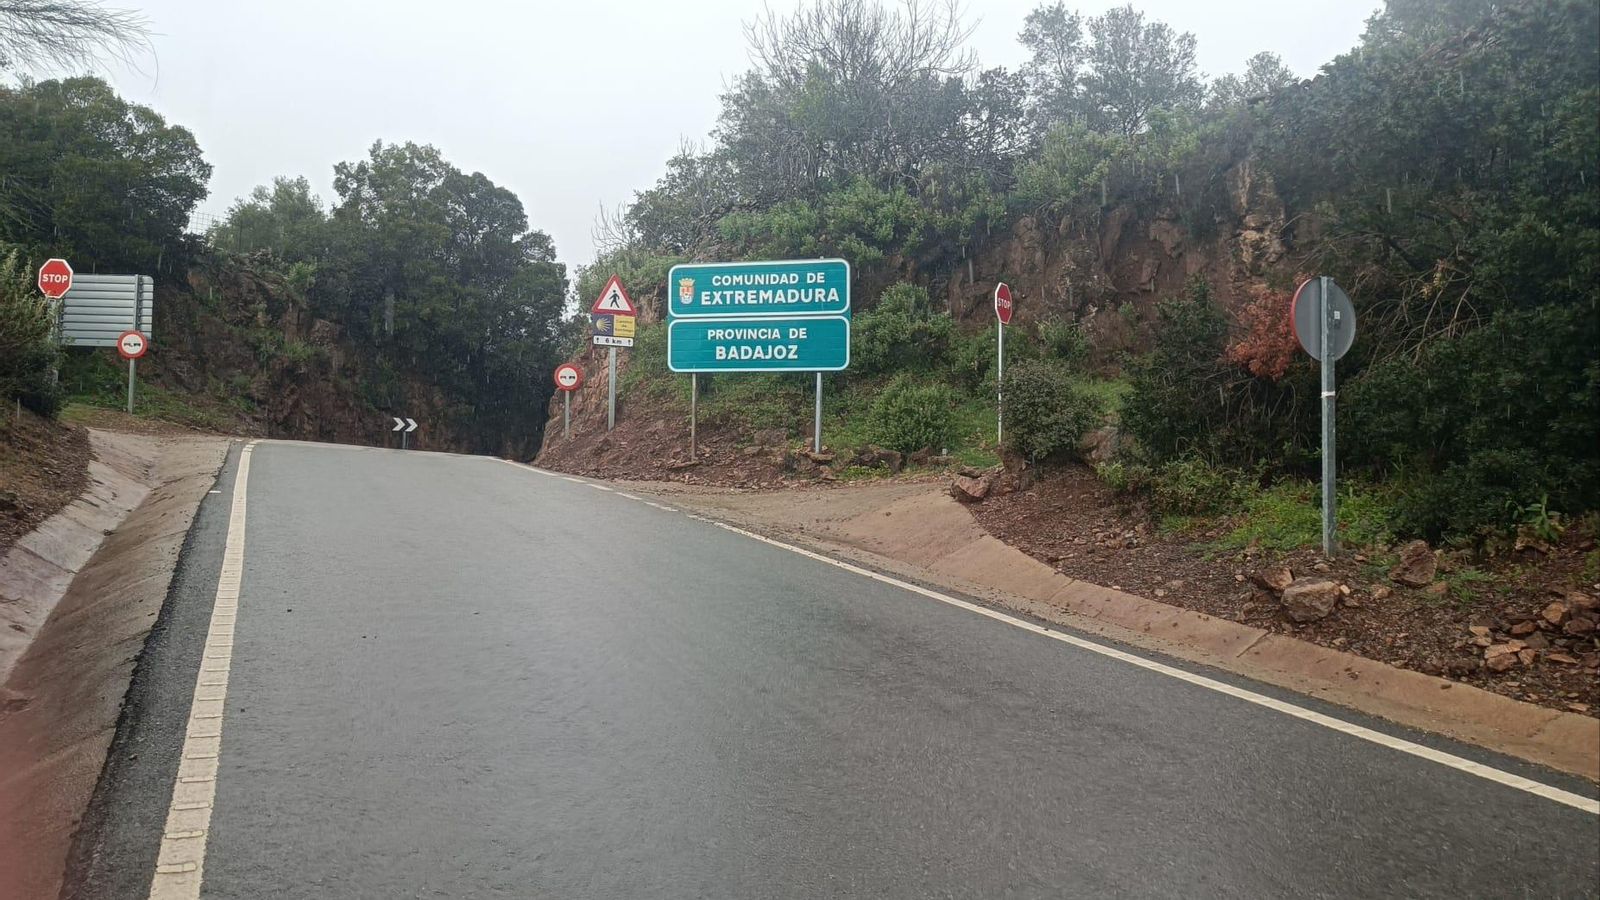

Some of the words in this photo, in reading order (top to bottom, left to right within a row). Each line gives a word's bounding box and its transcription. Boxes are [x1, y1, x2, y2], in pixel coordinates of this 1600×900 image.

[42, 273, 69, 283] STOP
[712, 273, 799, 286] COMUNIDAD
[806, 272, 825, 284] DE
[701, 287, 839, 305] EXTREMADURA
[997, 297, 1011, 310] STOP
[707, 328, 781, 340] PROVINCIA
[789, 327, 807, 339] DE
[715, 345, 798, 360] BADAJOZ
